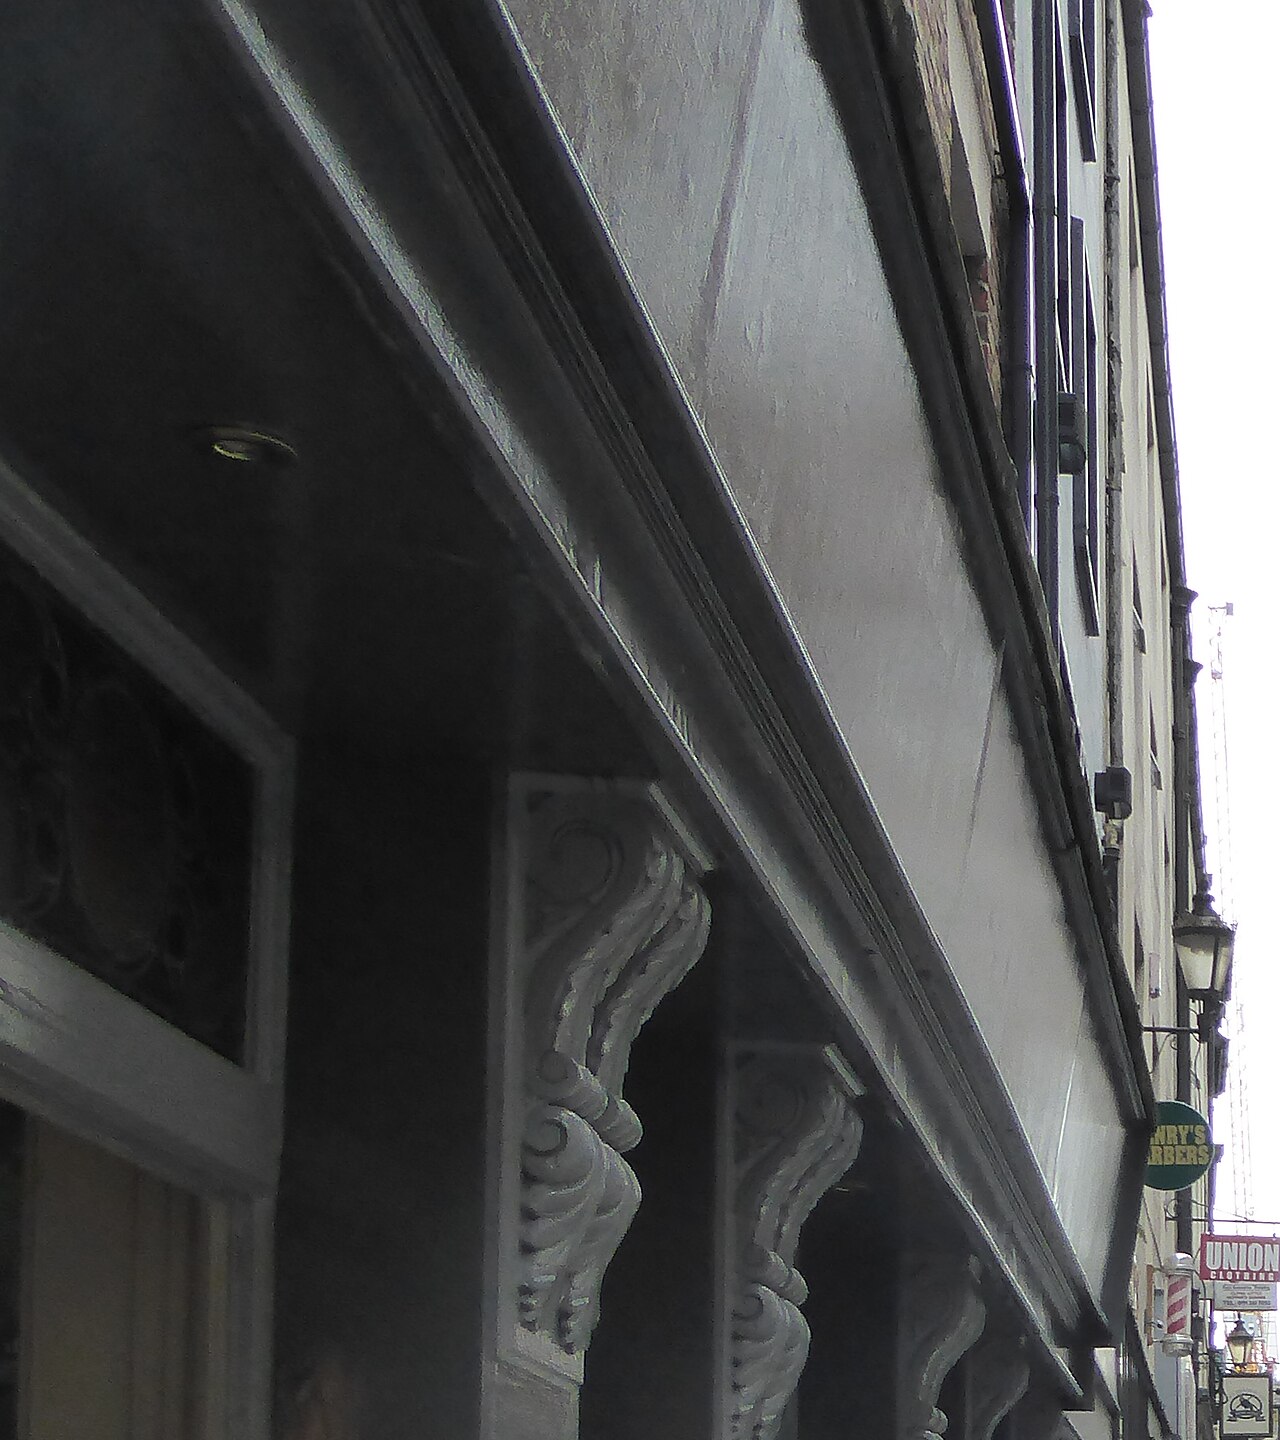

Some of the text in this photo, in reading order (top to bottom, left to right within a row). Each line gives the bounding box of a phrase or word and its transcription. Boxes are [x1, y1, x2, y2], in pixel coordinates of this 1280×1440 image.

[1150, 1125, 1205, 1144] NRY'S
[1149, 1145, 1209, 1165] RBERS
[1205, 1241, 1280, 1272] UNION
[1210, 1270, 1274, 1281] CLOTHING
